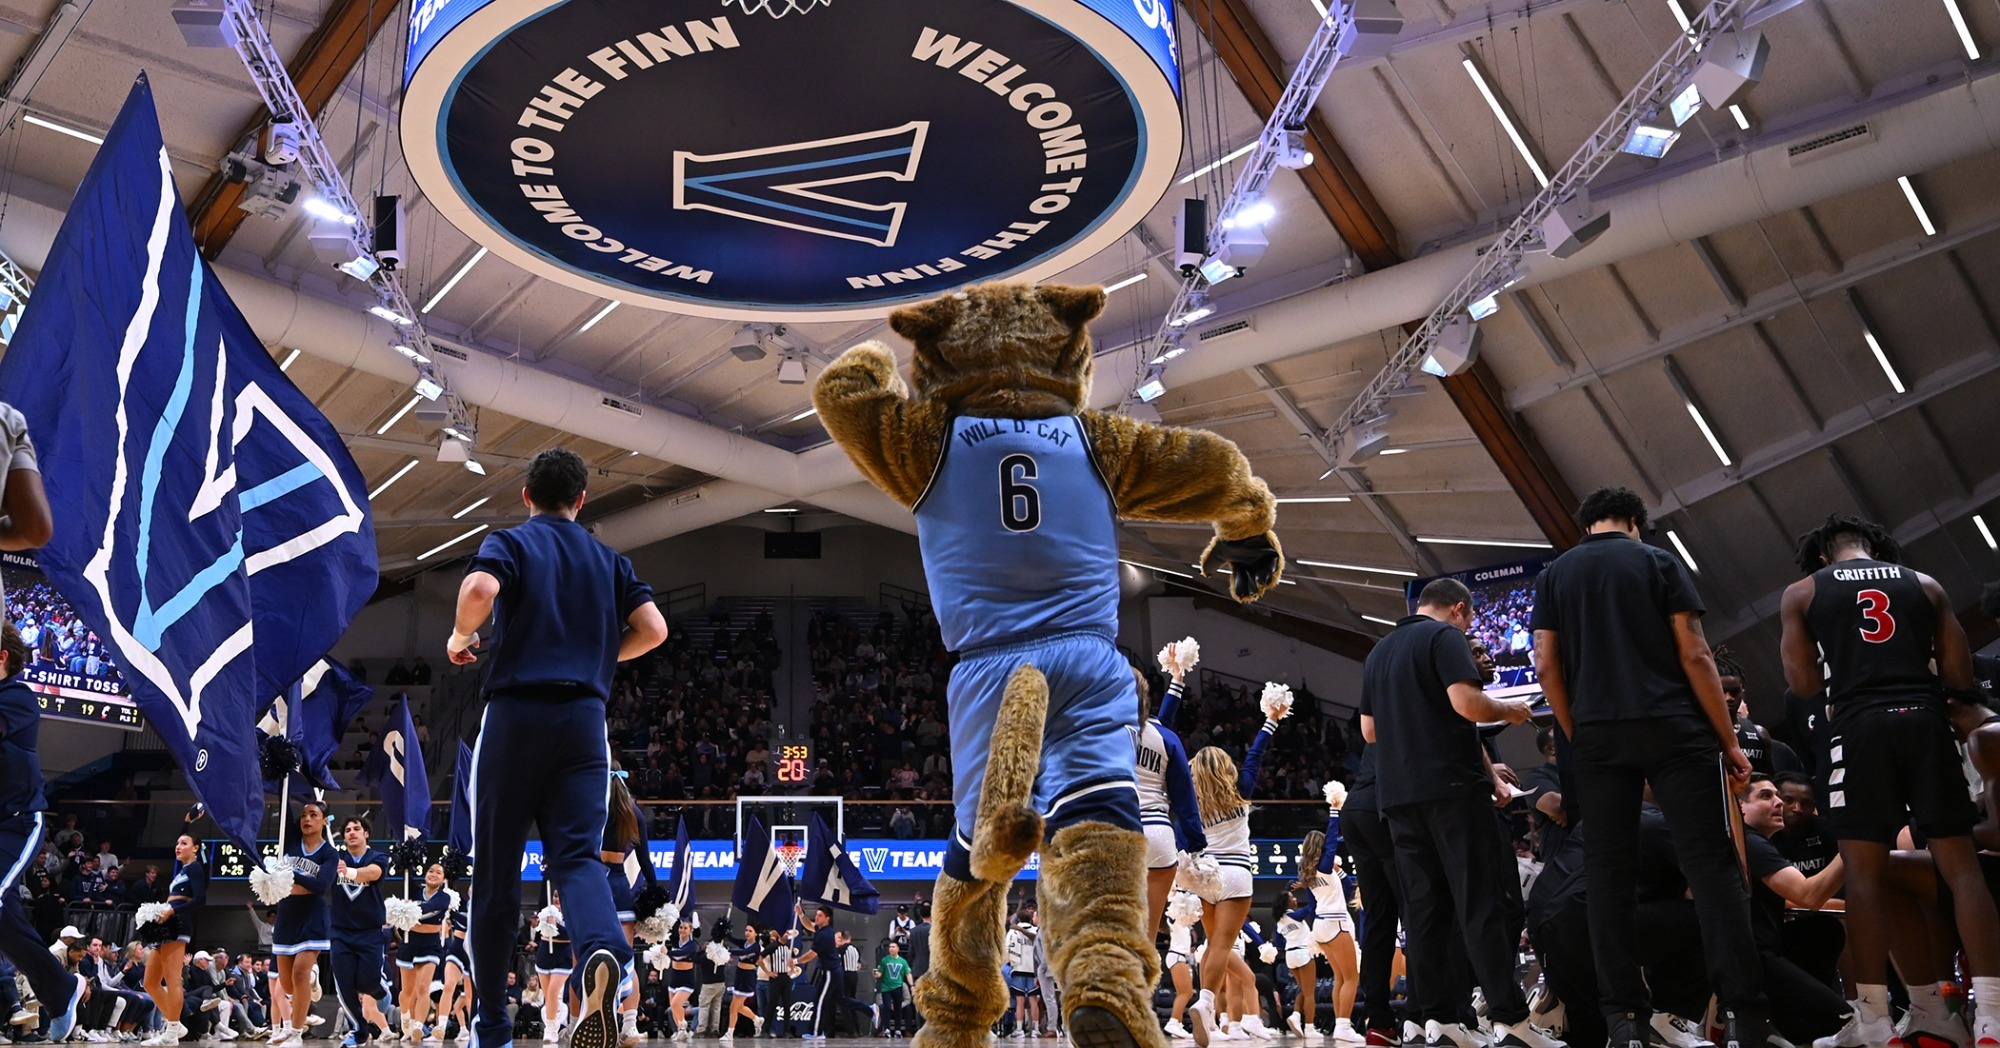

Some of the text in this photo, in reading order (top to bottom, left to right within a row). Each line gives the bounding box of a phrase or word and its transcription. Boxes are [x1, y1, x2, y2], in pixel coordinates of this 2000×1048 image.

[511, 16, 740, 284] WELCOME TO THE FINN
[846, 26, 1087, 289] WELCOME TO THE FINN
[959, 420, 1007, 447] WILL
[1037, 422, 1072, 448] CAT
[999, 453, 1041, 532] 6
[1475, 565, 1524, 582] COLEMAN
[1833, 566, 1901, 581] GRIFFITH
[1856, 589, 1895, 643] 3
[23, 668, 120, 694] T-SHIRT TOSS
[82, 704, 95, 716] 19
[783, 746, 808, 759] 3:53
[778, 759, 804, 781] 20
[1273, 844, 1281, 855] 3
[221, 865, 244, 875] 9-25
[1275, 864, 1283, 875] 6
